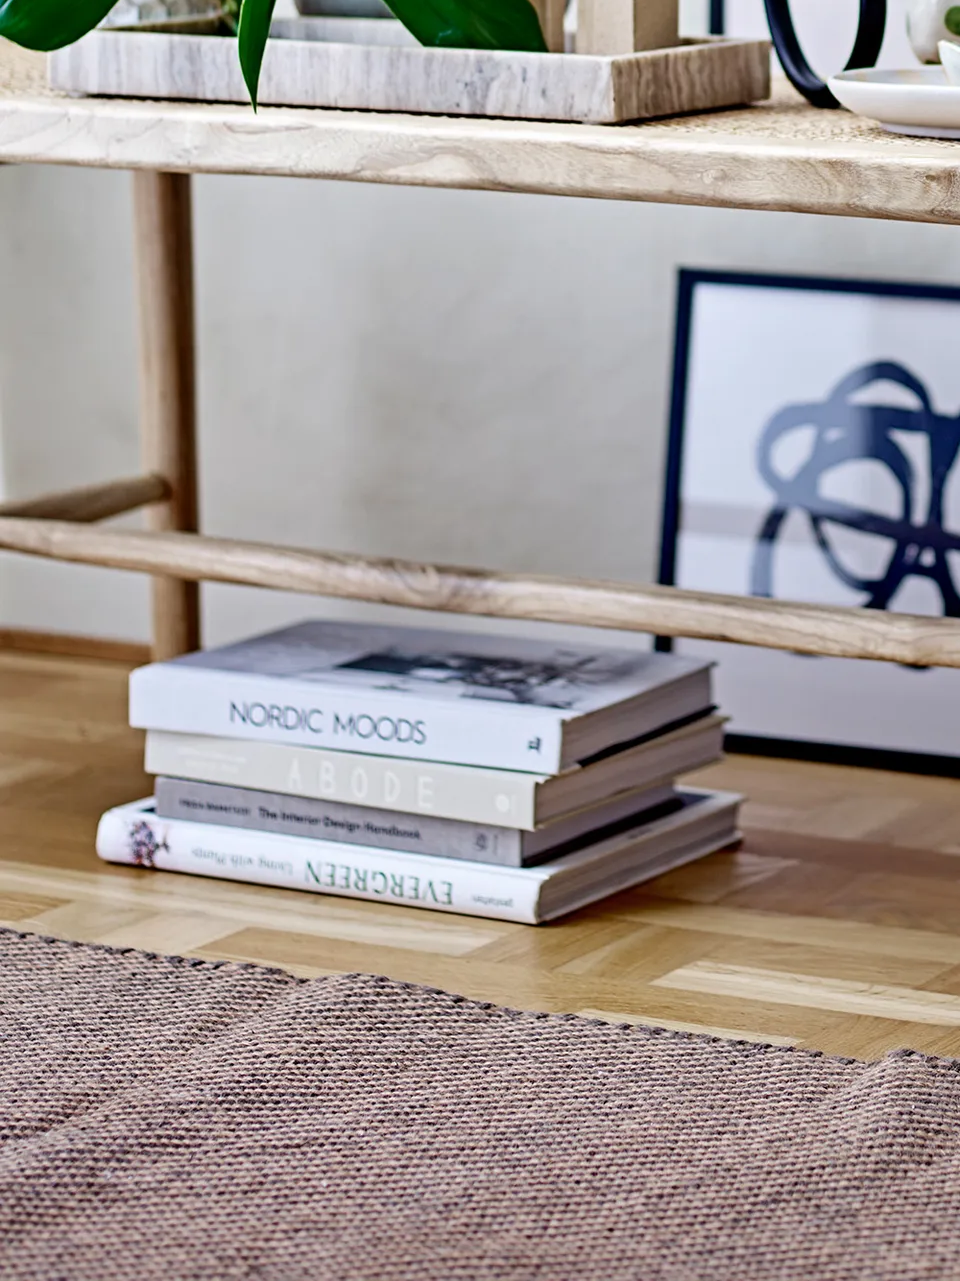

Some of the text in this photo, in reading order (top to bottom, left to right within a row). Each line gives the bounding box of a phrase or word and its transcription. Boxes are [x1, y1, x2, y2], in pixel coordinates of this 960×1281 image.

[229, 700, 427, 745] NORDIC MOODS
[287, 756, 435, 810] ABODE
[258, 806, 278, 821] The
[281, 810, 321, 827] Interior
[322, 816, 360, 834] Design
[364, 822, 421, 841] Handbook
[305, 859, 454, 906] EVERGREEN
